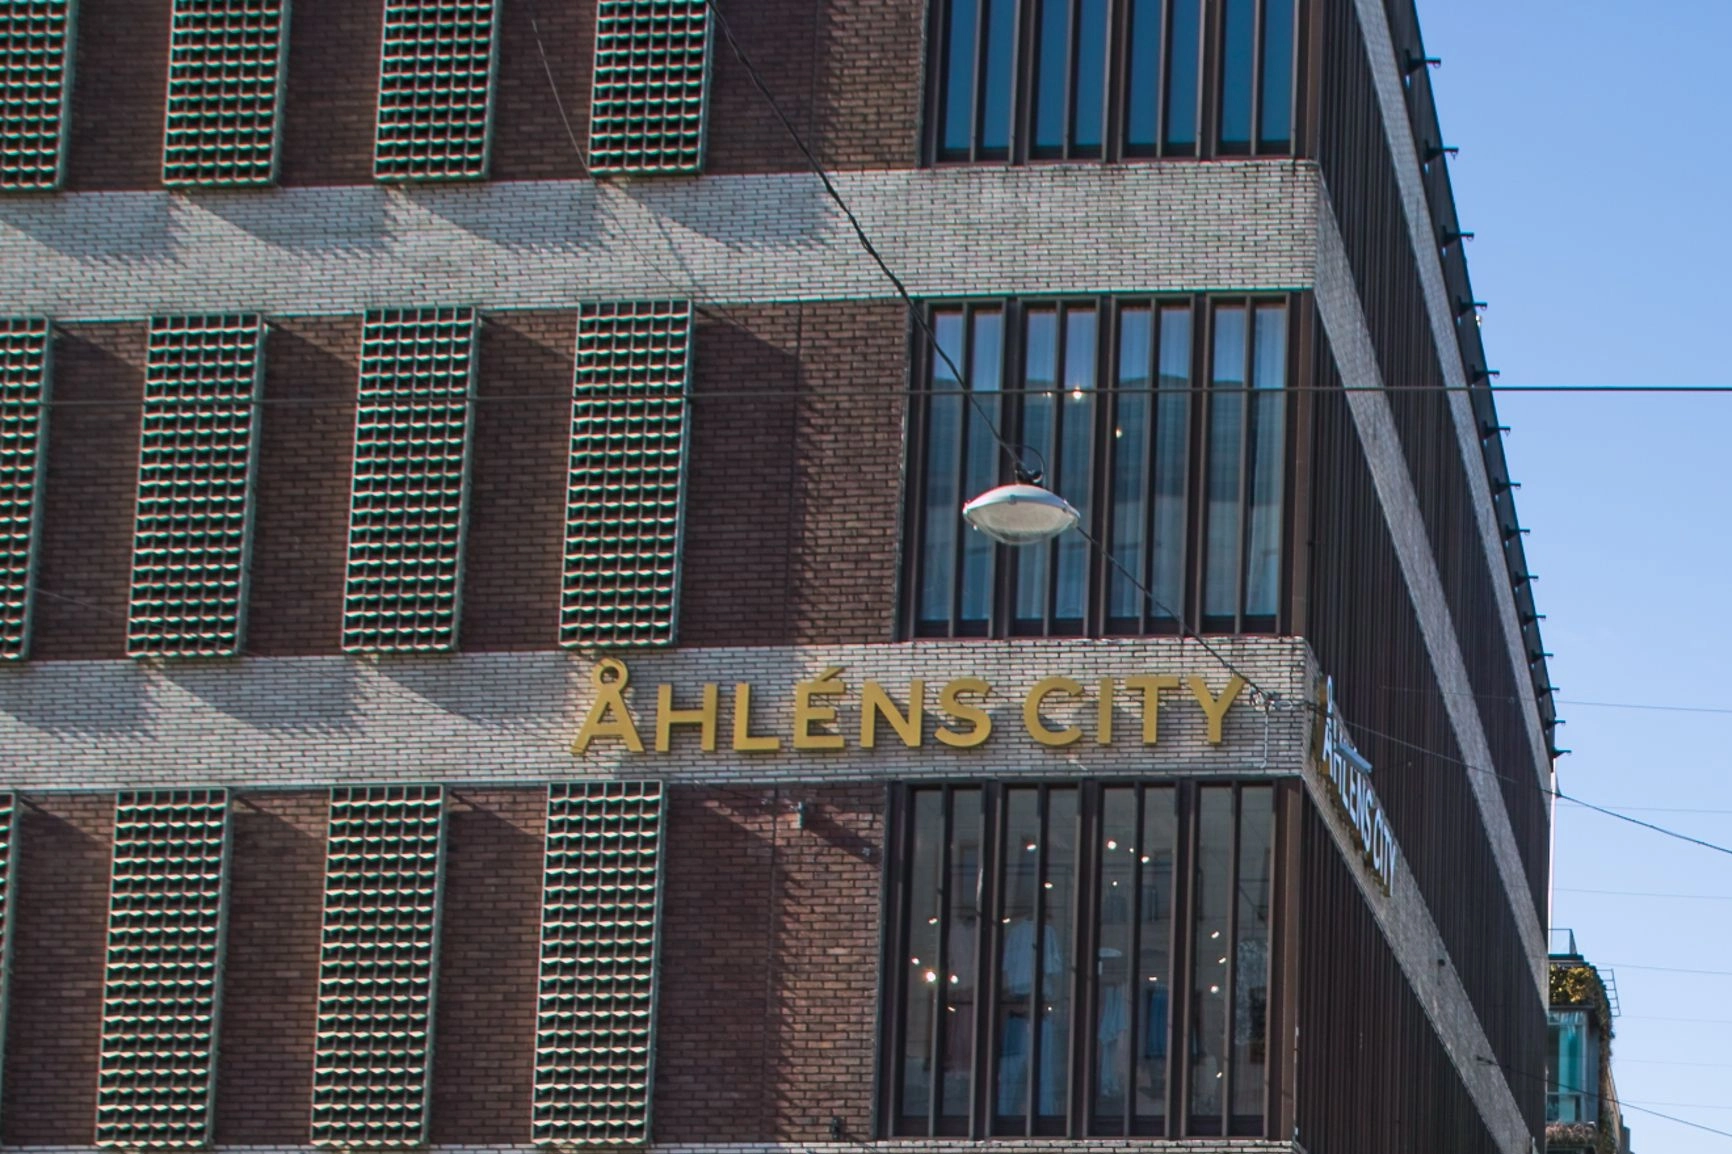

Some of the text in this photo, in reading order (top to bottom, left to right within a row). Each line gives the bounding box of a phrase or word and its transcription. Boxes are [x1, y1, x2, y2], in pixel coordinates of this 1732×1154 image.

[571, 657, 1245, 755] ÅHLÉNS CITY
[1373, 807, 1396, 897] CITY
